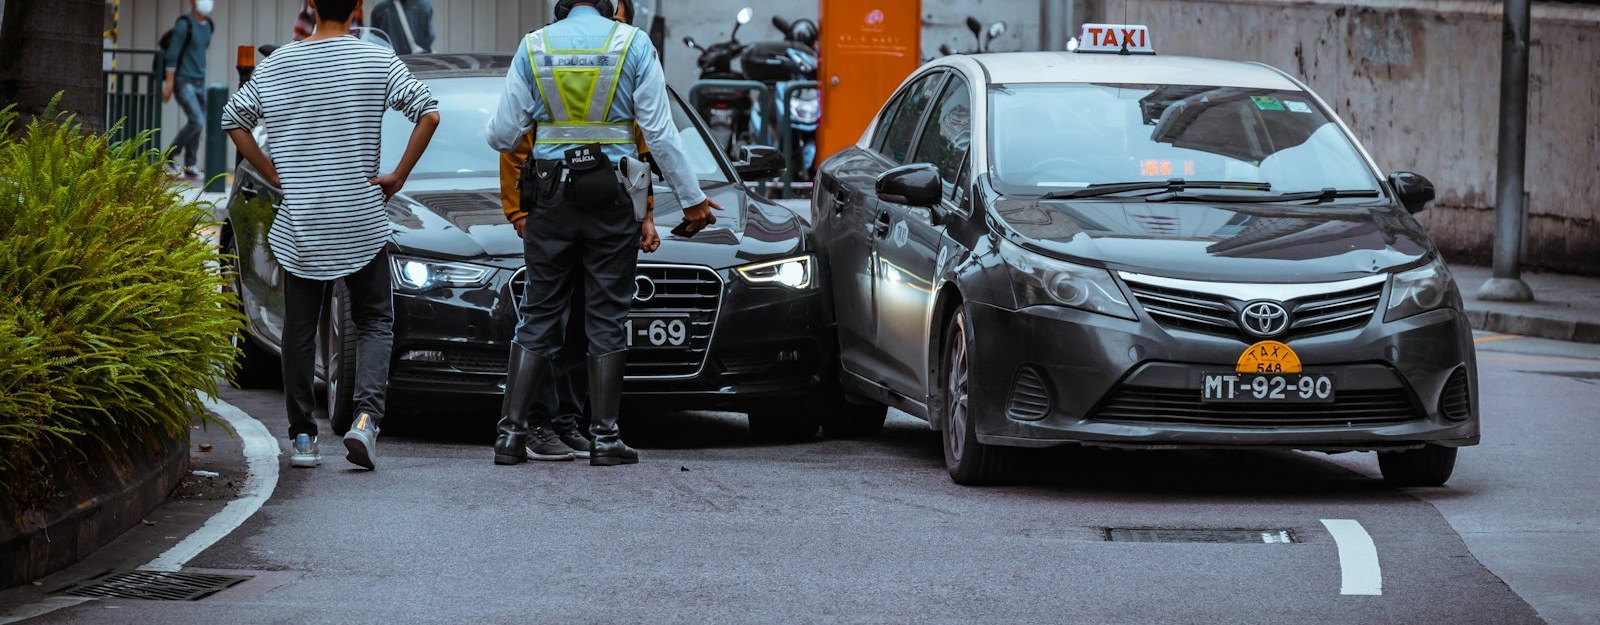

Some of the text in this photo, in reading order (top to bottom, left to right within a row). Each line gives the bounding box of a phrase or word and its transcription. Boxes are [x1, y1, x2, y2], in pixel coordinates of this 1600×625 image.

[1088, 28, 1145, 47] TAXI
[1248, 345, 1289, 361] TAXI
[1256, 363, 1282, 373] 548
[1205, 375, 1332, 399] MT-92-90
